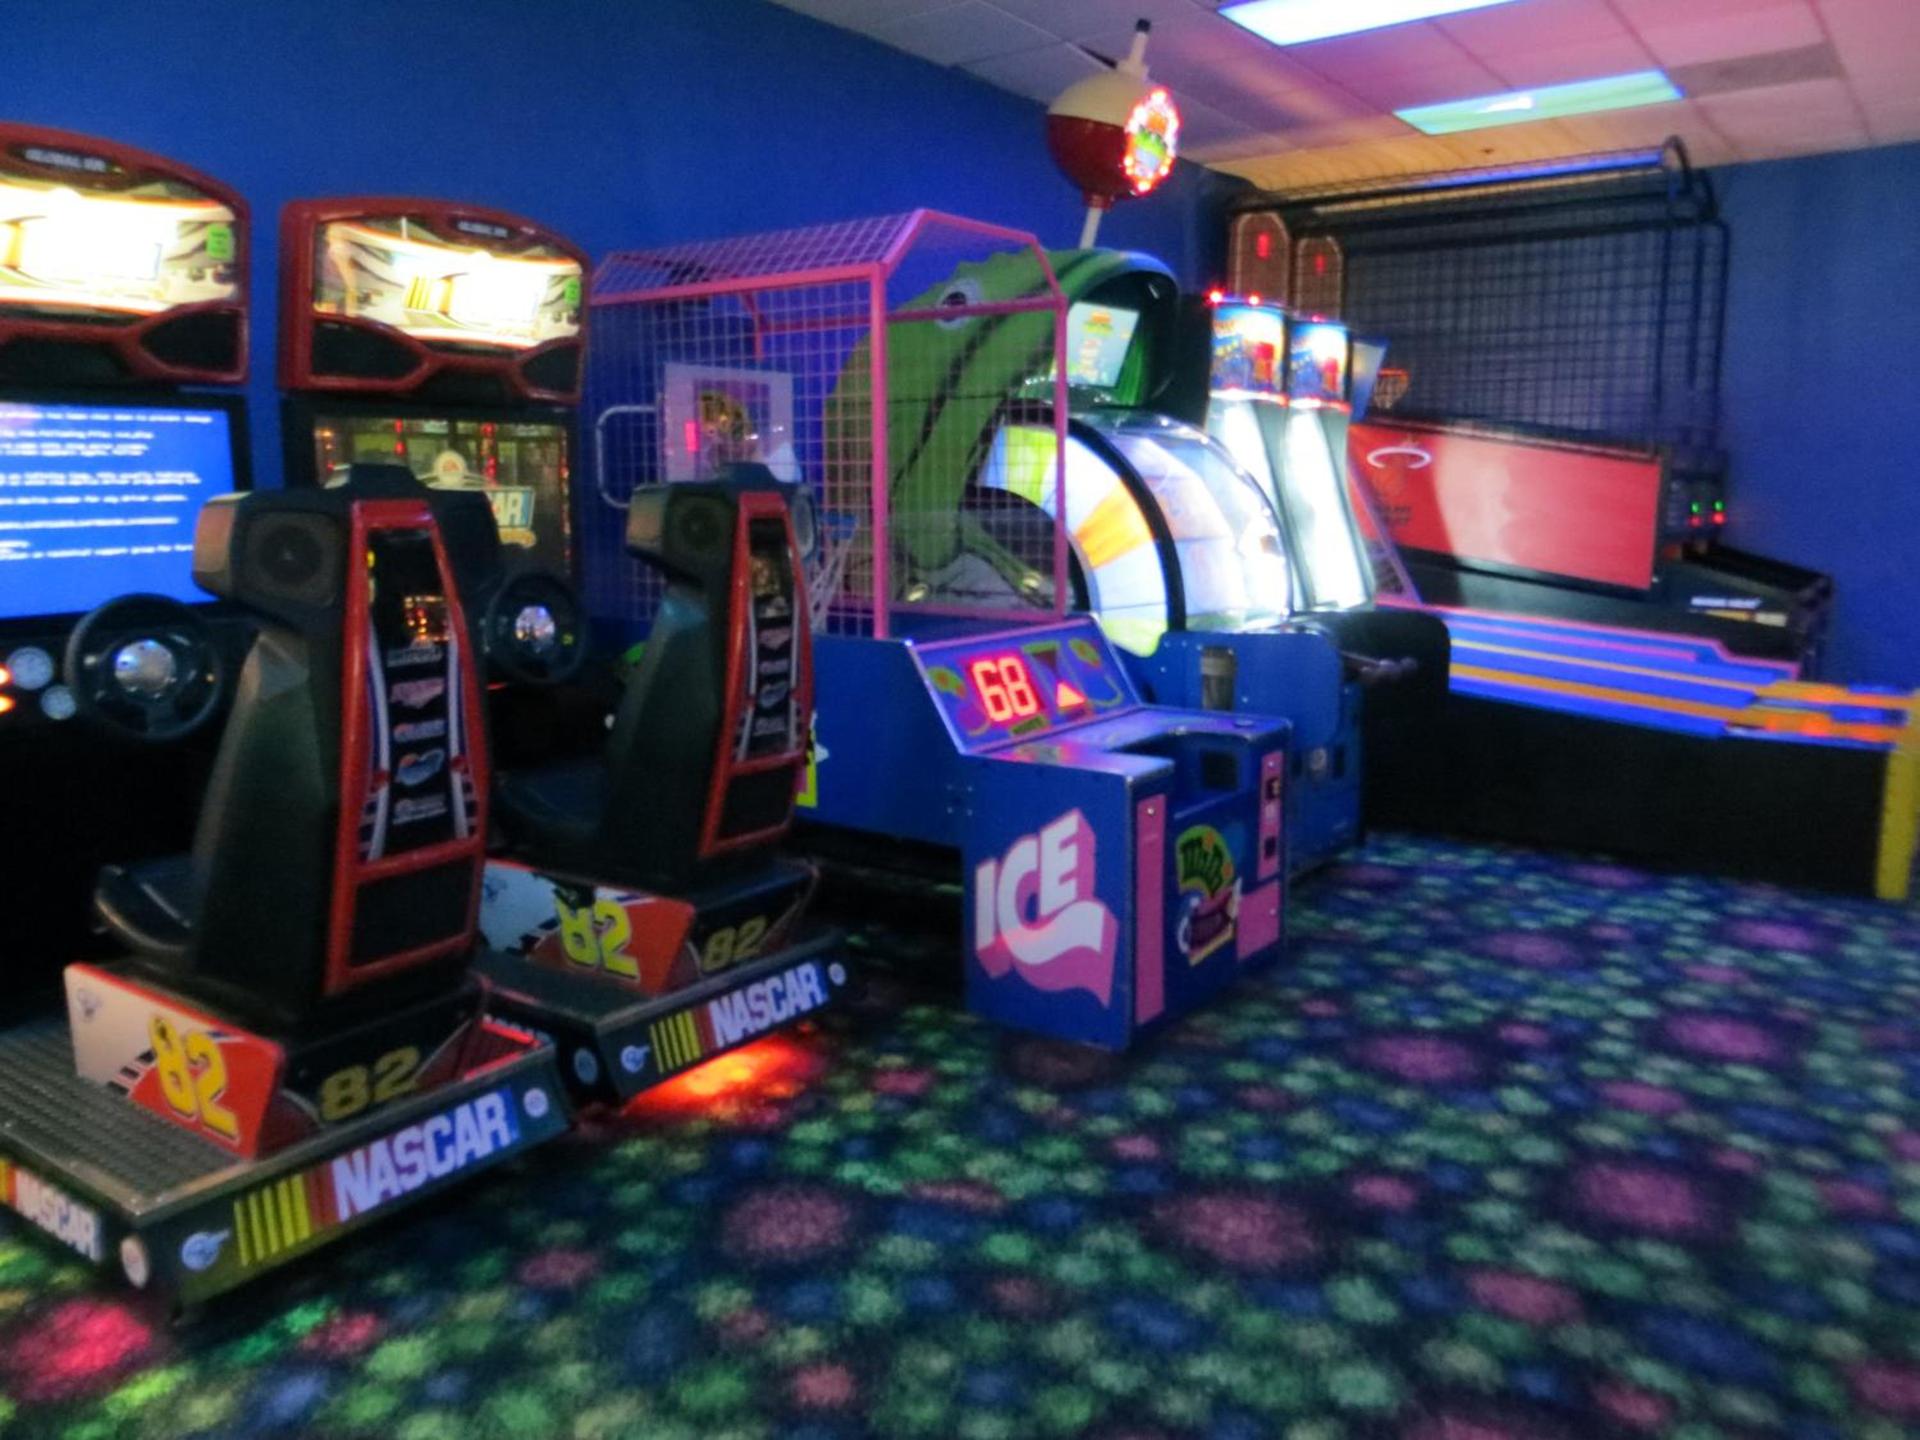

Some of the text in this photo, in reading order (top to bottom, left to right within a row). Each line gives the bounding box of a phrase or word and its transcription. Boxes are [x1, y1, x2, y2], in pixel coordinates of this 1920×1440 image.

[973, 656, 1040, 722] 68
[553, 883, 640, 979] 82
[975, 810, 1107, 972] ICE
[701, 915, 768, 972] 82
[708, 962, 823, 1048] NASCAR
[148, 1015, 240, 1142] 82
[320, 1046, 420, 1122] 82
[331, 1090, 512, 1223] NASCAR
[16, 1166, 101, 1262] NASCAR
